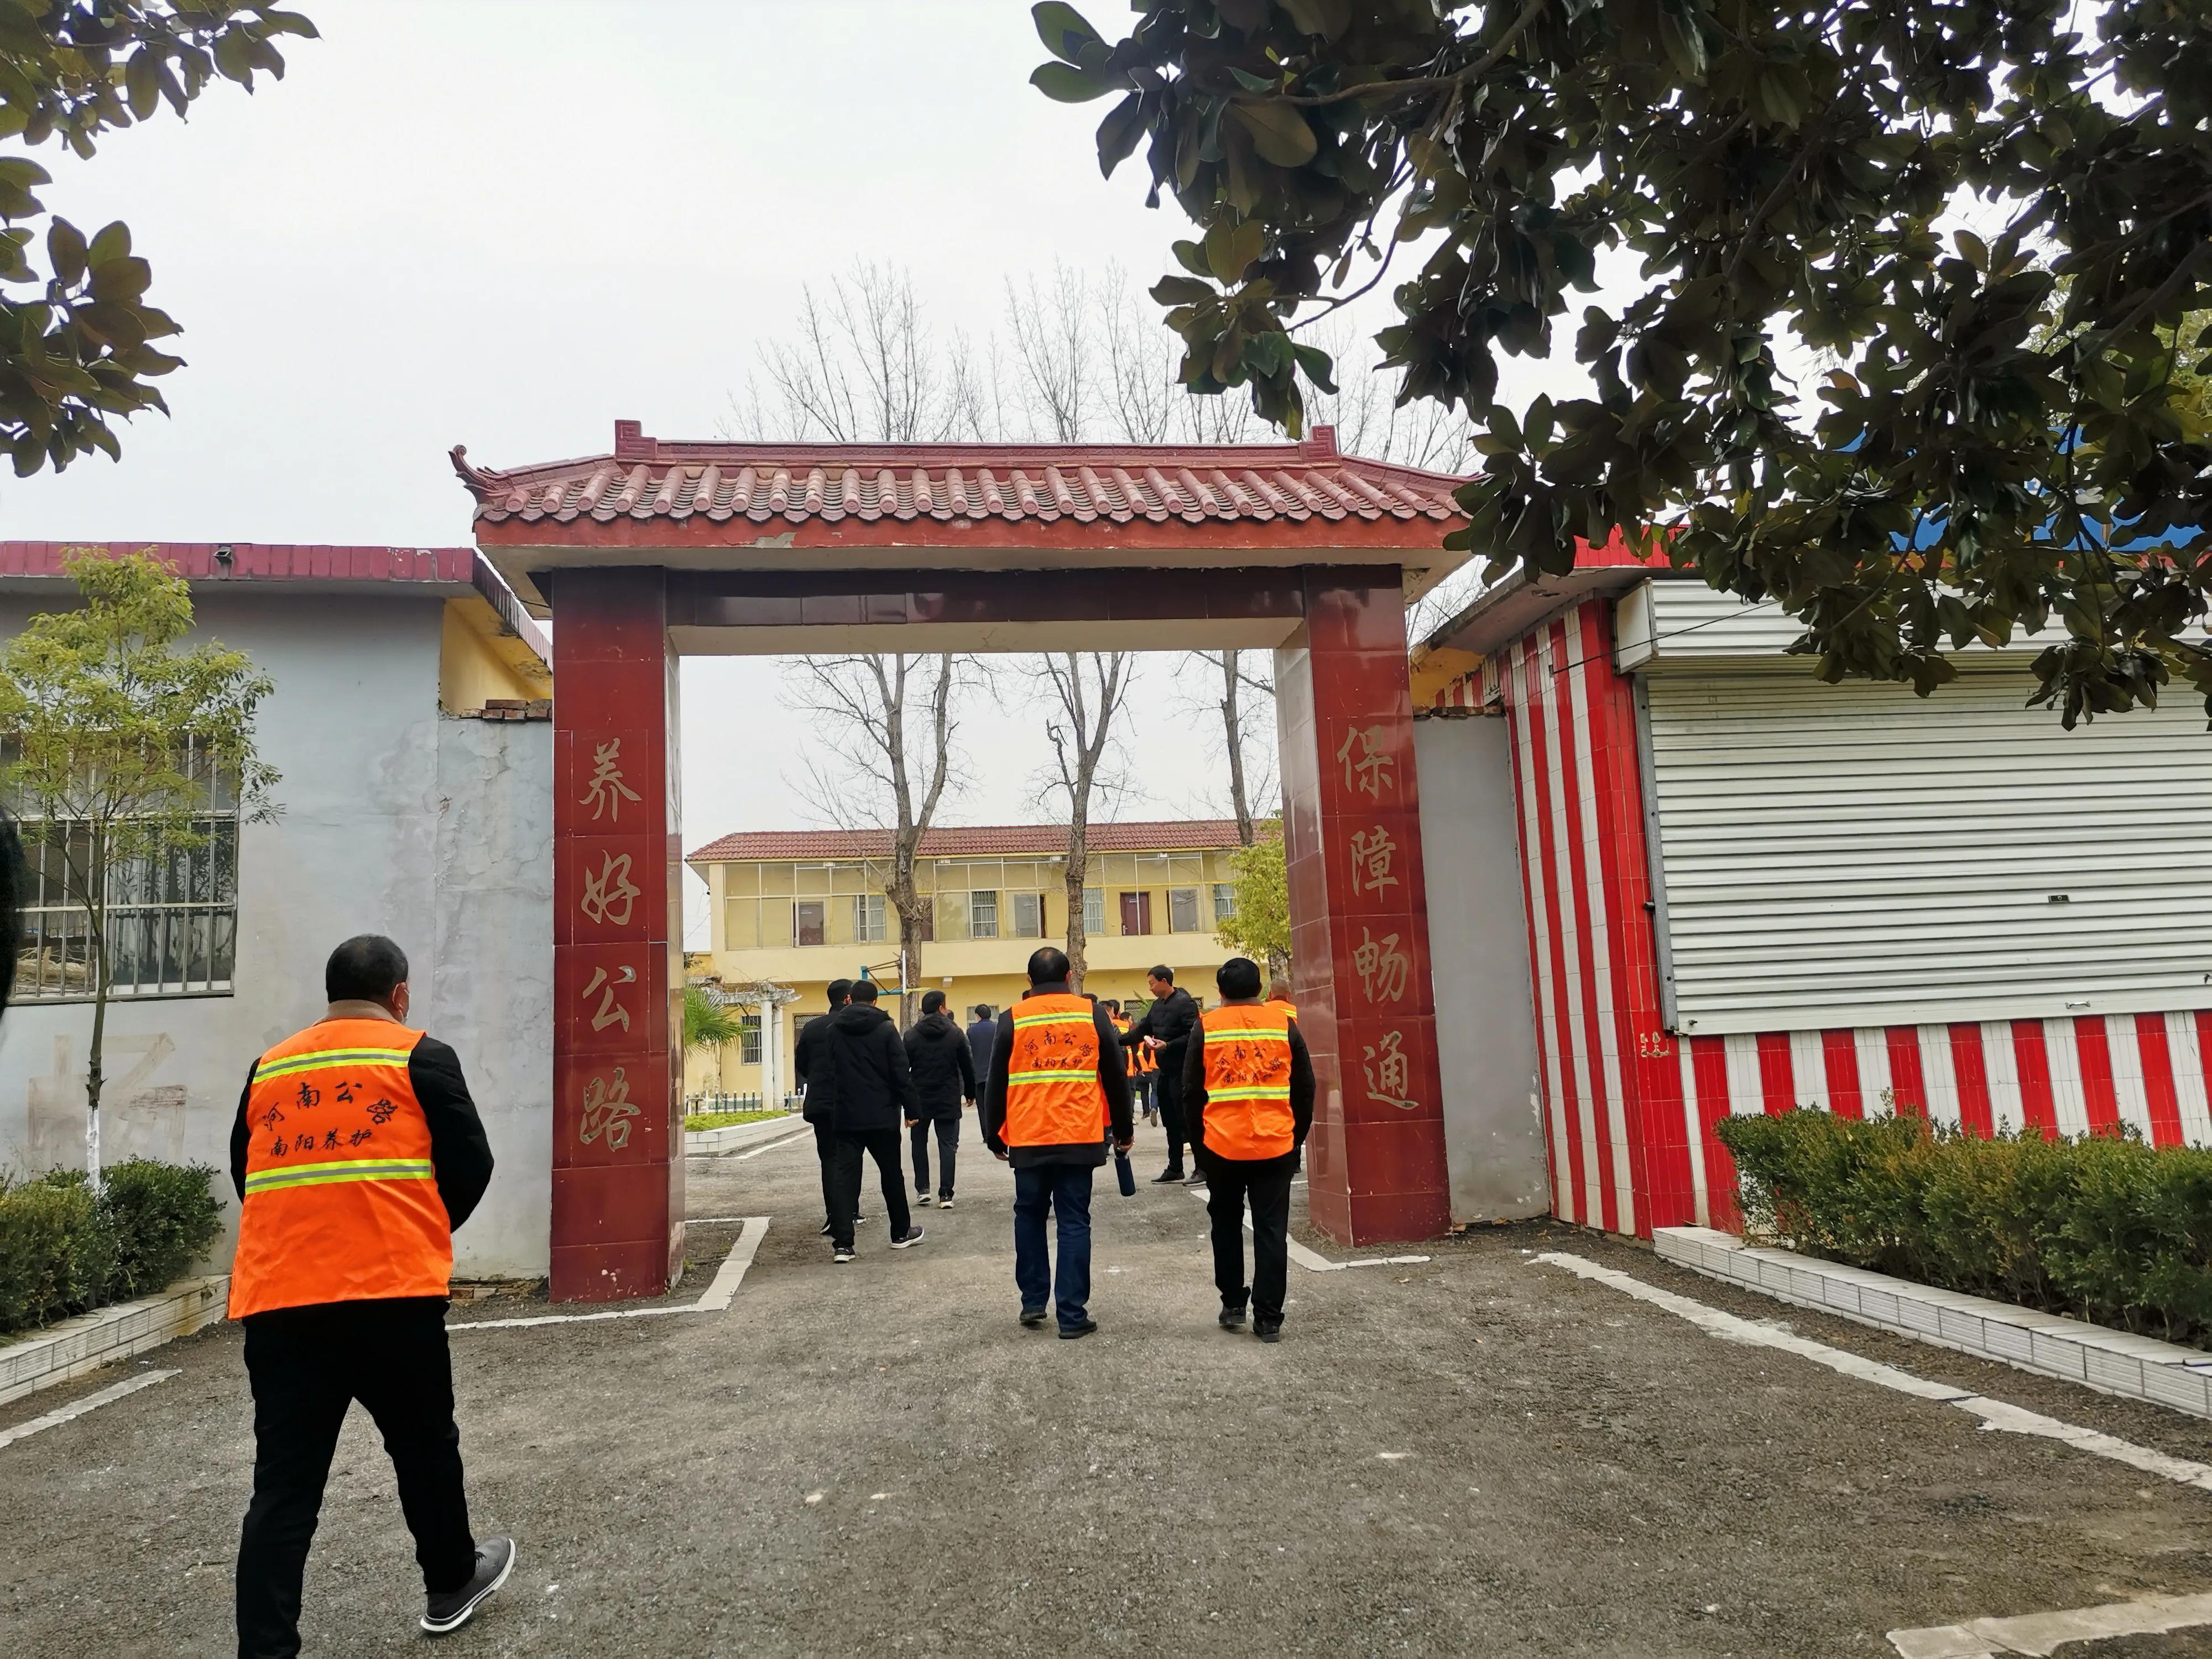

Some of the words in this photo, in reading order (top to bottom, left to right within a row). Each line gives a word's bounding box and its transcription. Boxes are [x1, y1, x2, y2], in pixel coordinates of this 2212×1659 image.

[1337, 723, 1420, 1110] 保障畅通
[579, 737, 642, 1154] 养好公路
[1024, 1030, 1093, 1057] 河南公路
[262, 1082, 398, 1131] 河南公路
[270, 1128, 372, 1157] 南阳养护
